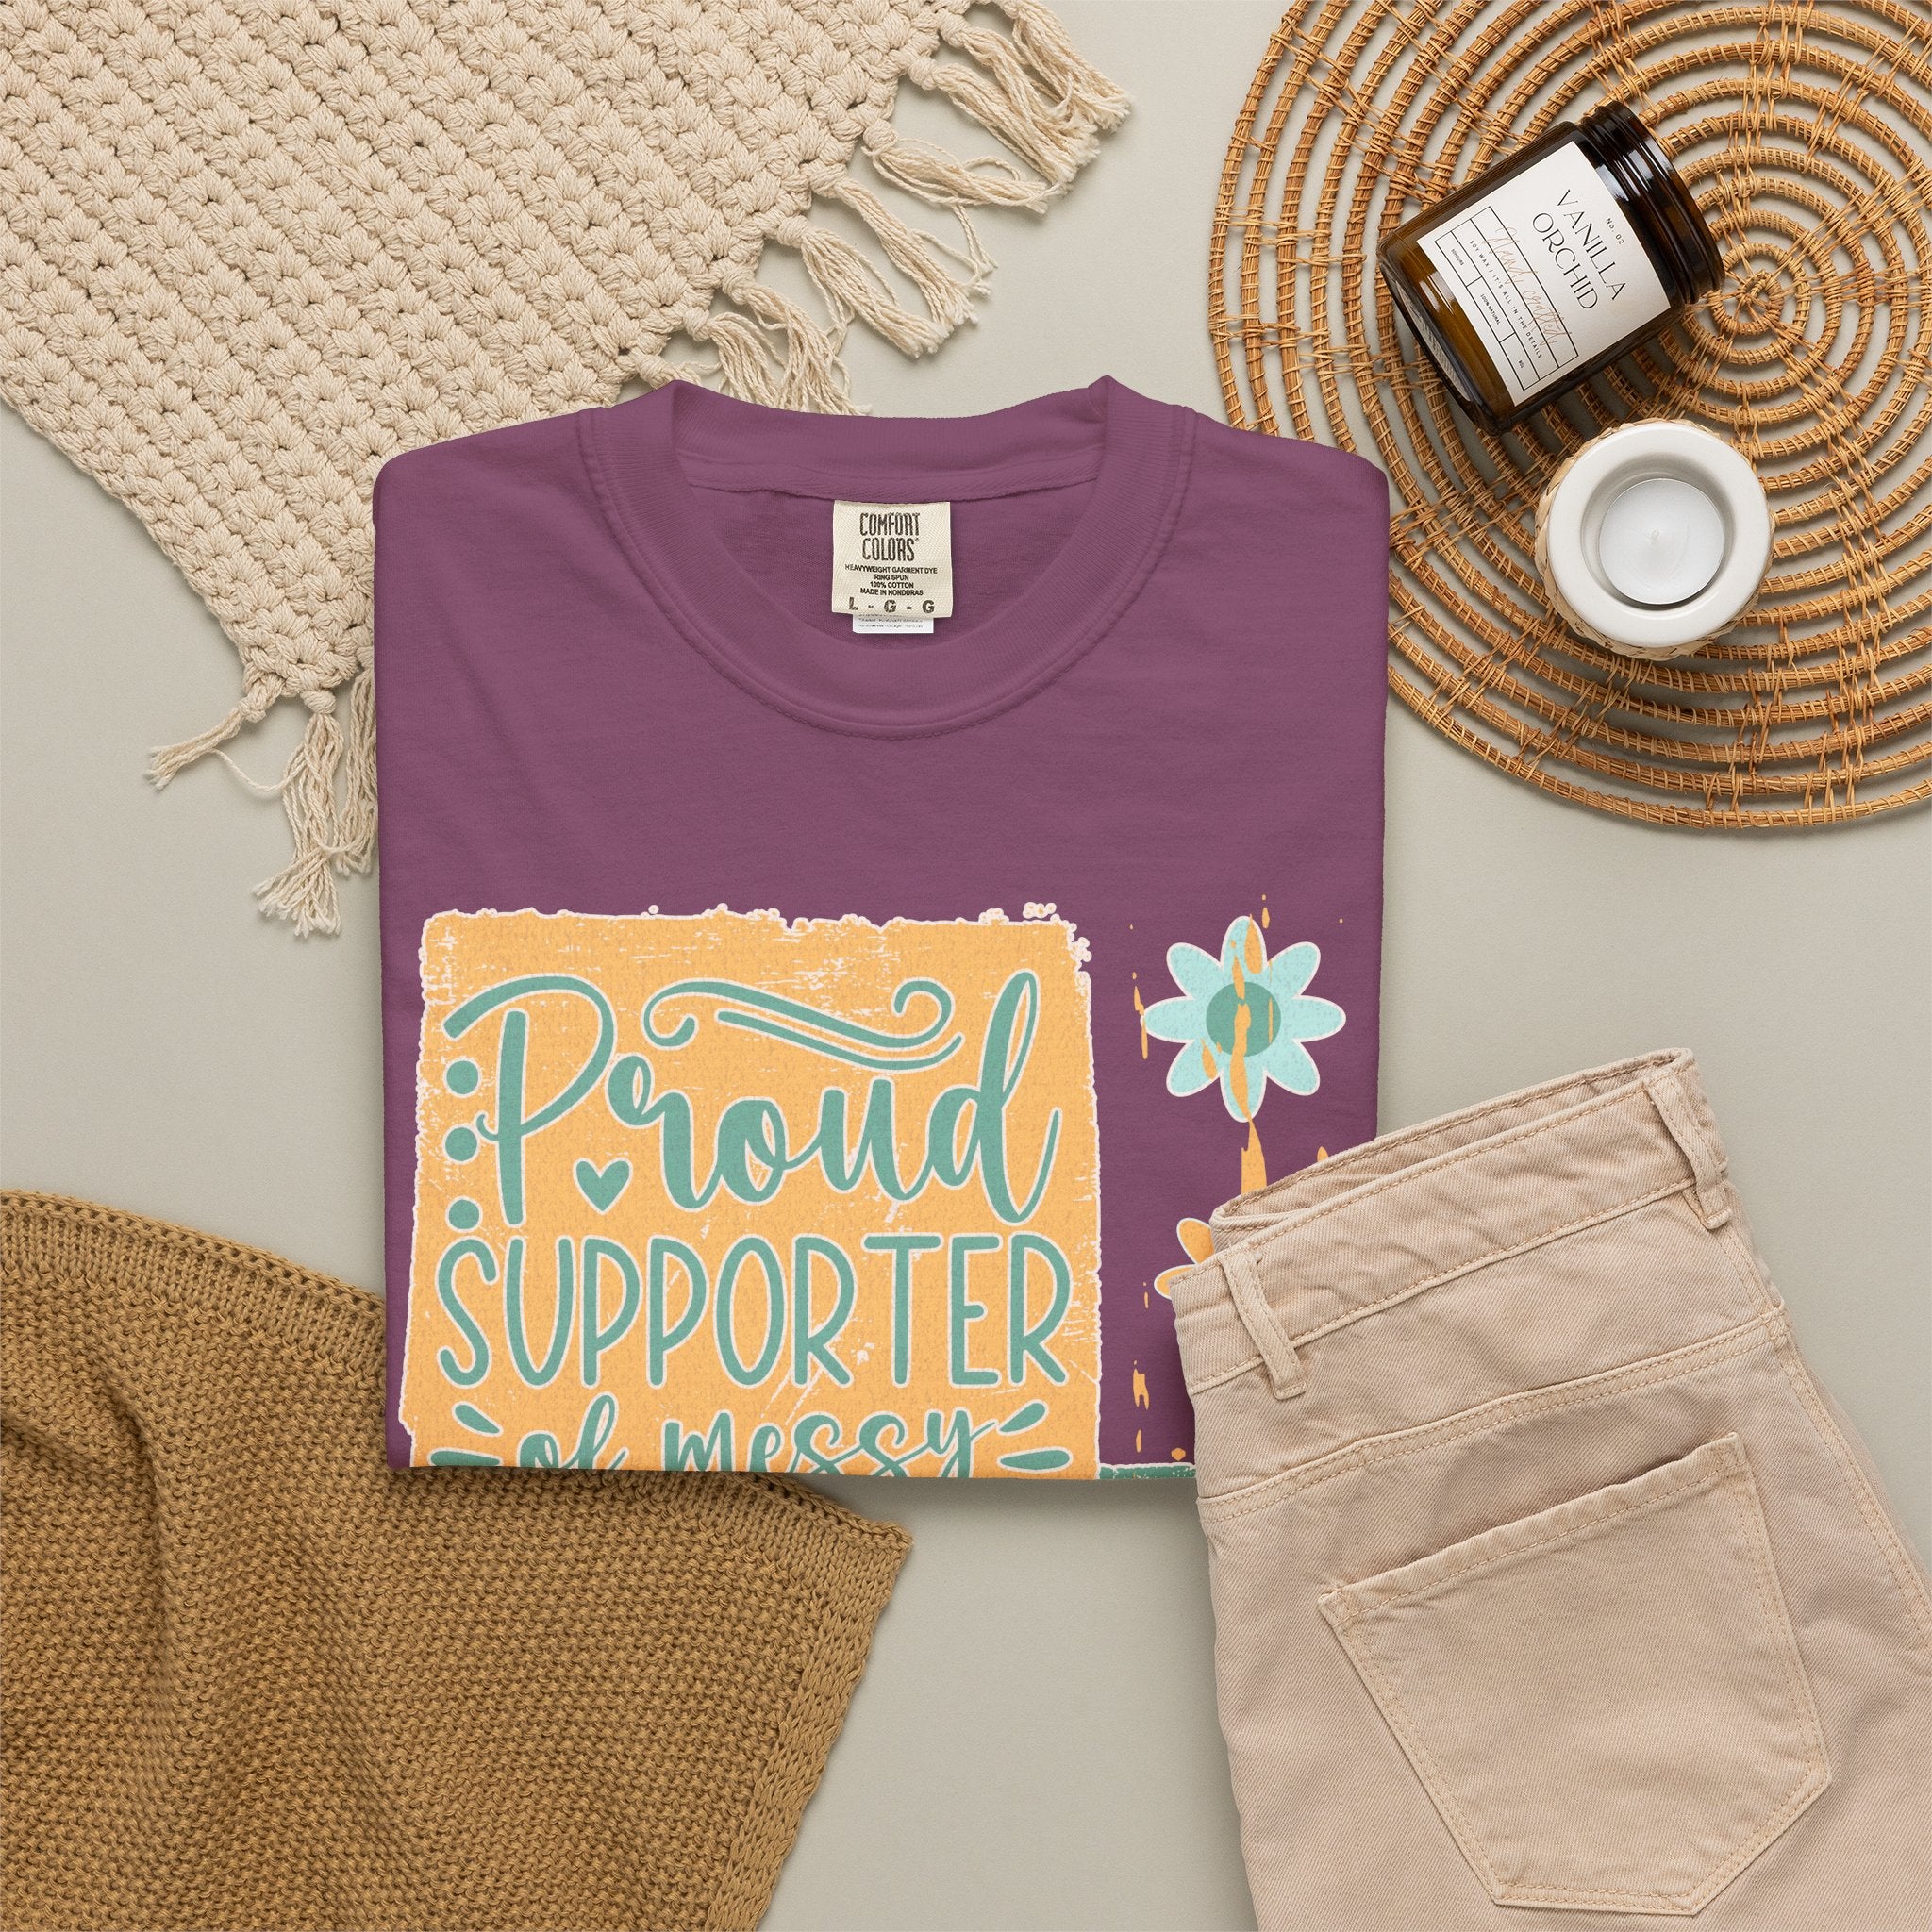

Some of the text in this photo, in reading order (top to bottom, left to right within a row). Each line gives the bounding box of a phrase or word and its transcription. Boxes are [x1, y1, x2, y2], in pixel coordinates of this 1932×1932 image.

[1532, 212, 1599, 309] ORCHID
[1557, 189, 1626, 301] VANILLA
[1470, 240, 1479, 252] SOY
[1479, 254, 1490, 267] WAX
[1492, 275, 1504, 289] IT'S
[1503, 291, 1512, 304] ALL
[1511, 306, 1519, 315] IN
[1518, 316, 1527, 329] THE
[1525, 332, 1542, 358] DETAILS
[844, 564, 891, 574] HEAVYWEIGHT
[891, 566, 924, 575] GARMENT
[859, 512, 920, 536] COMFORT
[860, 588, 879, 596] MADE
[884, 599, 897, 613] G
[922, 599, 935, 614] G
[441, 969, 1063, 1228] Proud
[436, 1234, 1072, 1387] SUPPORTER
